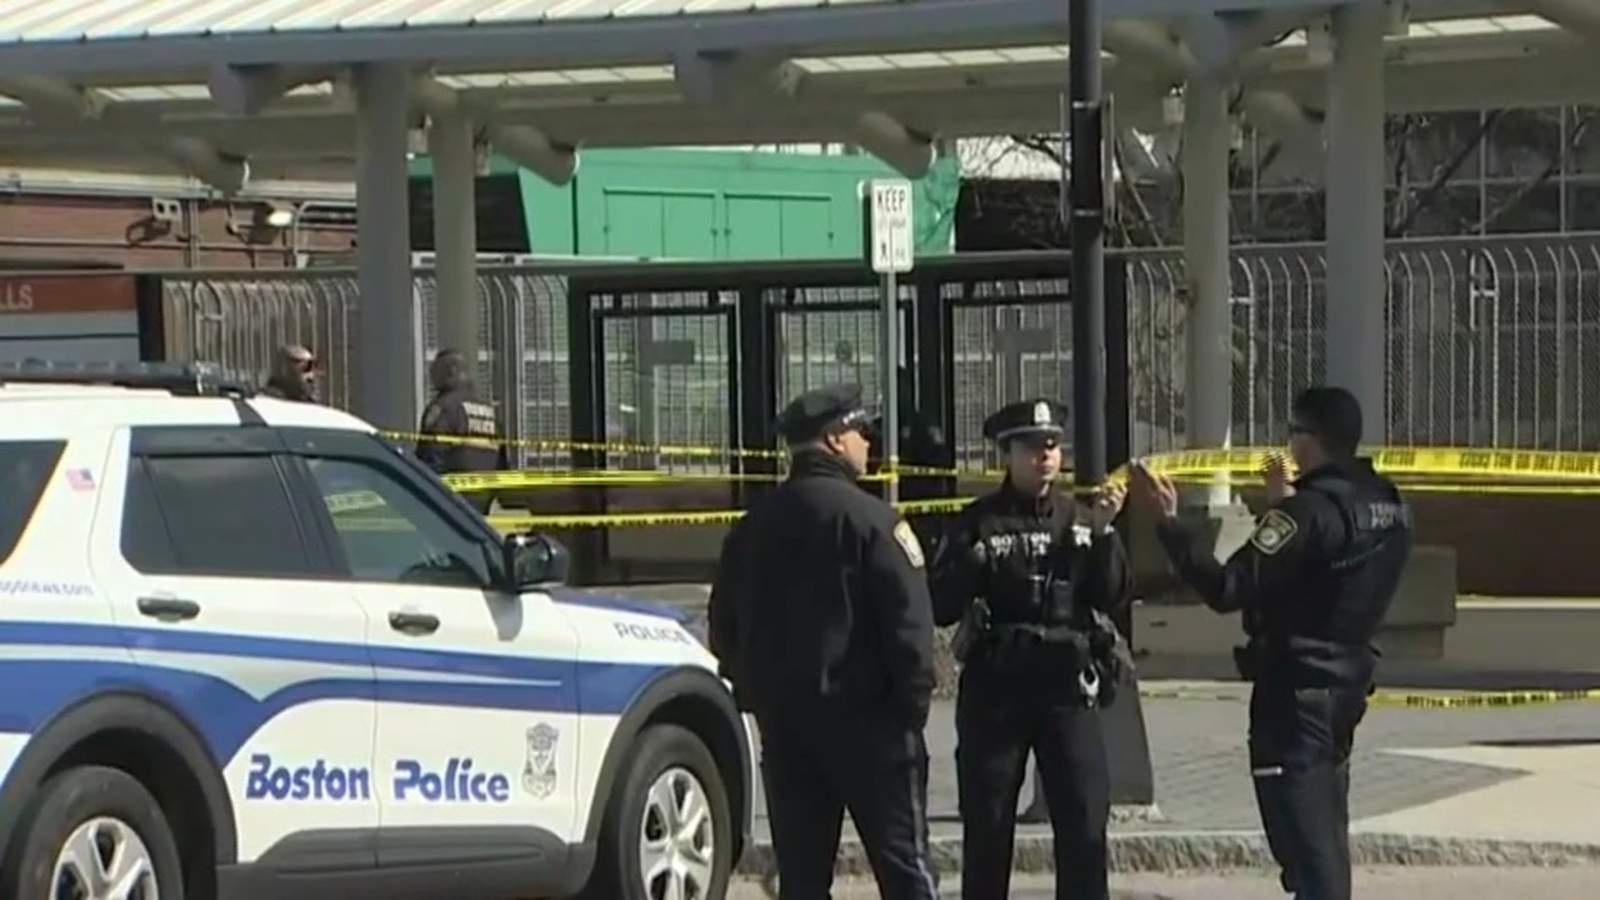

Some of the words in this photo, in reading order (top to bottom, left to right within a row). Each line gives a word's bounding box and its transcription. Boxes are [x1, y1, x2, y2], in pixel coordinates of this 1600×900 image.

[877, 188, 906, 213] KEEP
[613, 621, 692, 645] POLICE
[246, 753, 371, 801] Boston
[393, 757, 510, 803] Police
